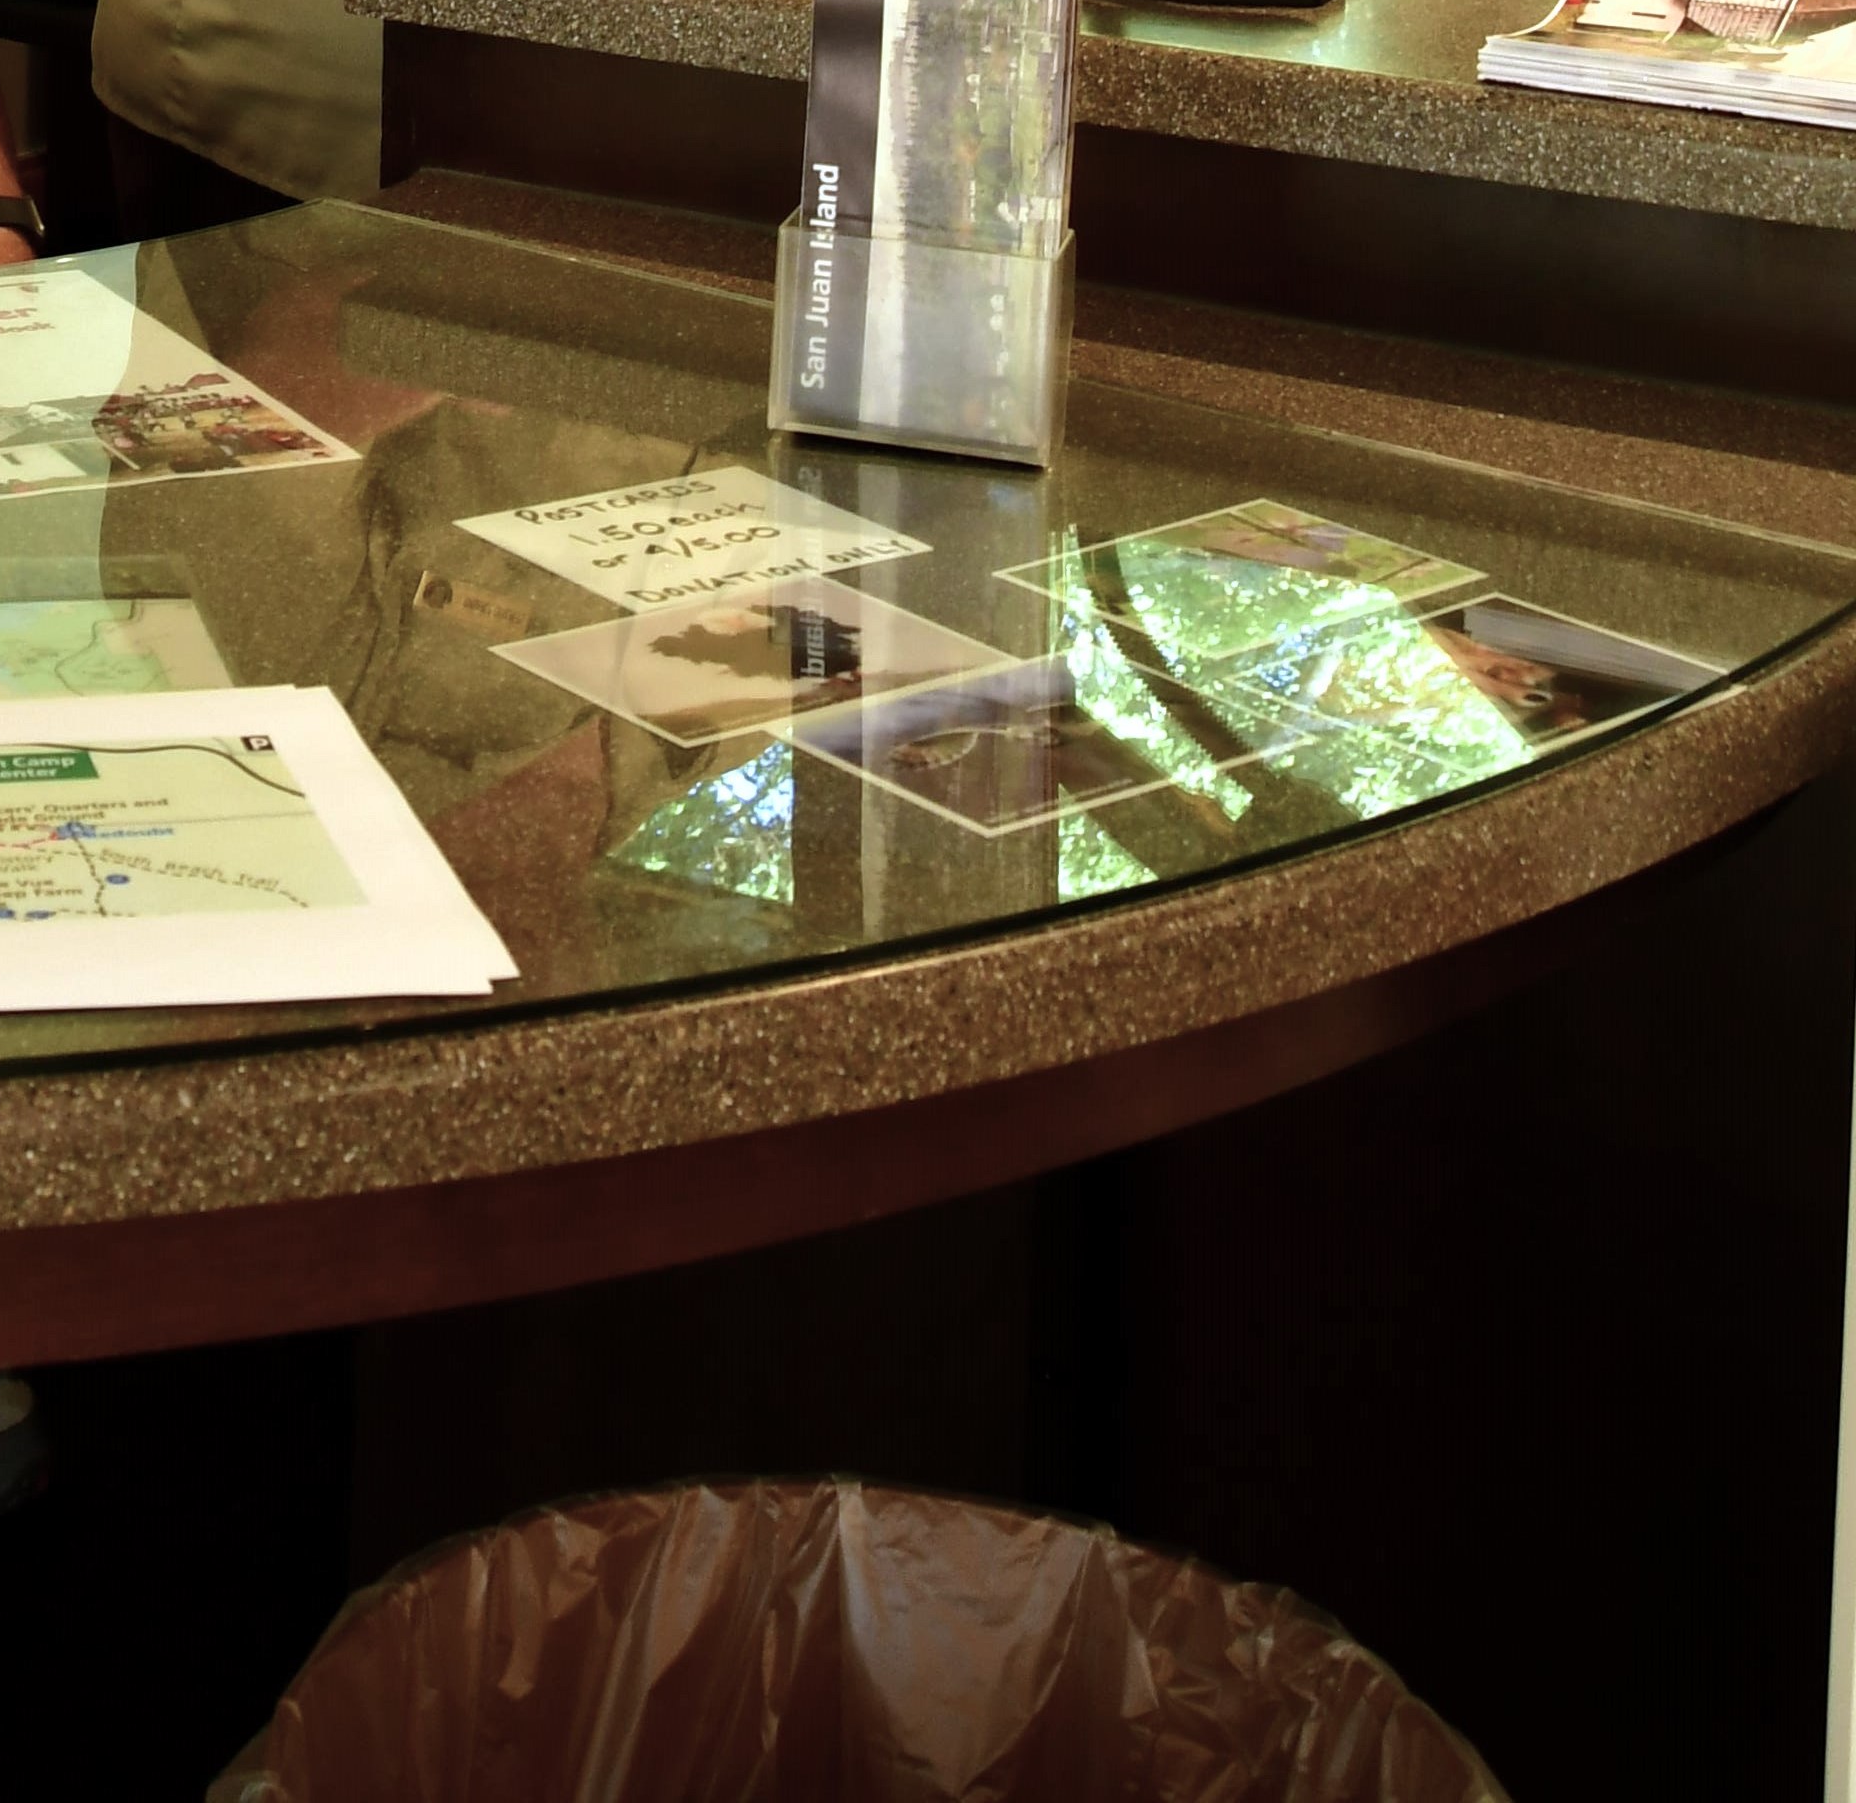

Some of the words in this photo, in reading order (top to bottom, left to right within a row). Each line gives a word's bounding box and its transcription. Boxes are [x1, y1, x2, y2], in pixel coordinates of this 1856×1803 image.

[809, 162, 840, 250] Island
[805, 259, 833, 328] Juan
[800, 335, 828, 391] San
[568, 520, 666, 548] 1.50
[667, 501, 768, 528] each
[591, 552, 630, 570] or
[825, 539, 915, 566] ONLY
[11, 755, 76, 769] Camp
[43, 800, 128, 814] Quarters
[133, 798, 169, 807] and
[33, 811, 105, 823] Ground
[16, 878, 54, 888] Vue
[34, 886, 83, 897] Farm
